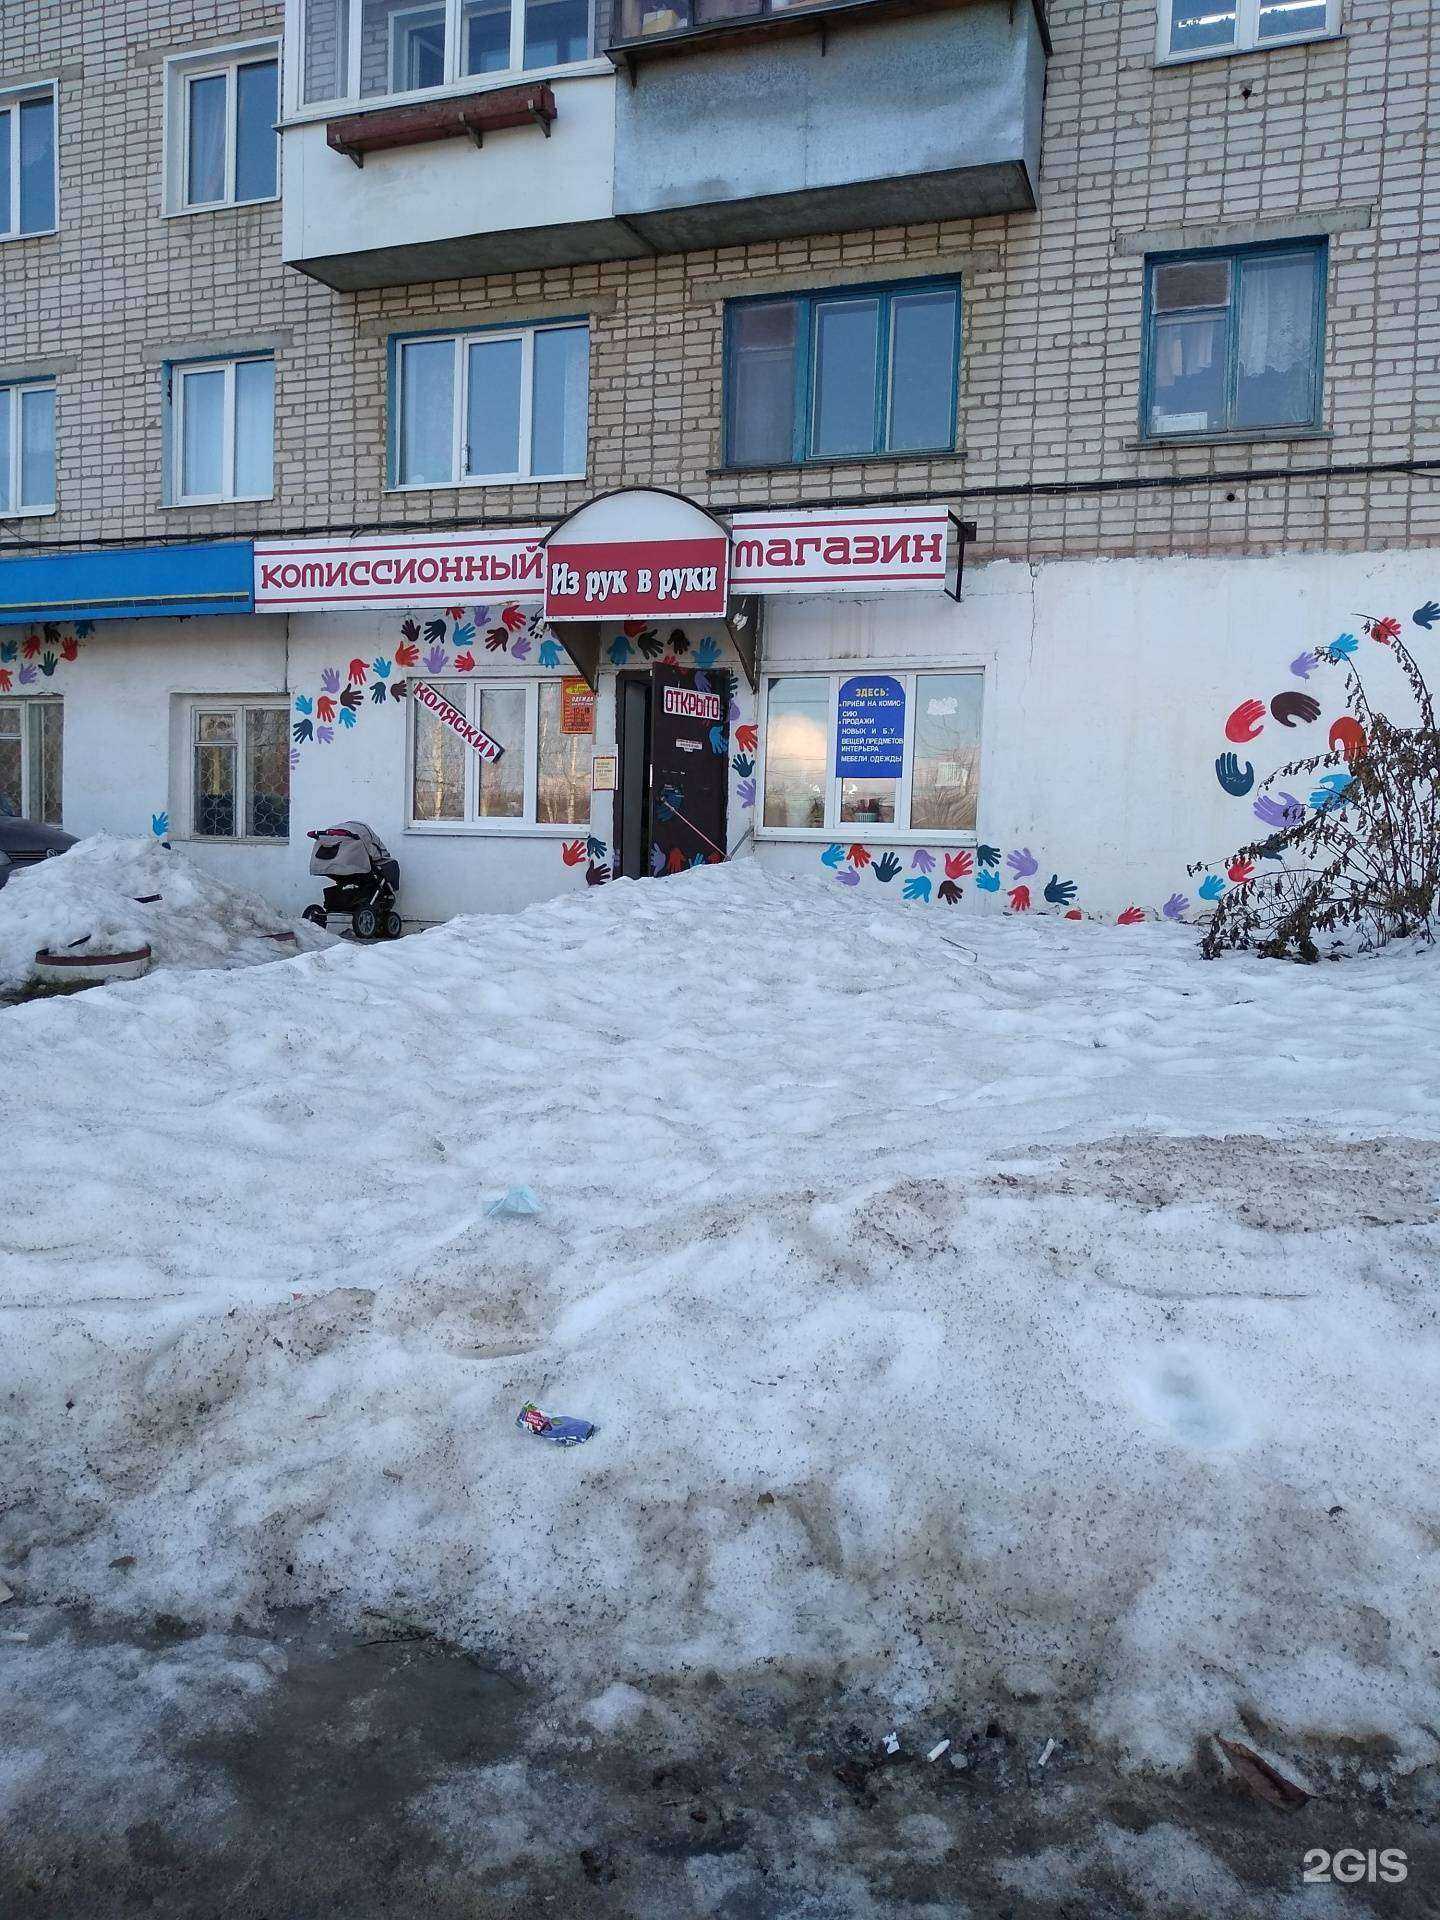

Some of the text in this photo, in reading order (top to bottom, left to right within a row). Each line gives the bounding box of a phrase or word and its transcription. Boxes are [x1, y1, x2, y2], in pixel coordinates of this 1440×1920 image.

[550, 562, 718, 601] Из рук в руки
[413, 681, 489, 754] КОЛЯСКИ
[665, 690, 719, 718] ОТКРЫТО
[841, 727, 866, 735] НОВЫХ
[869, 755, 902, 763] ОДЕЖДЫ
